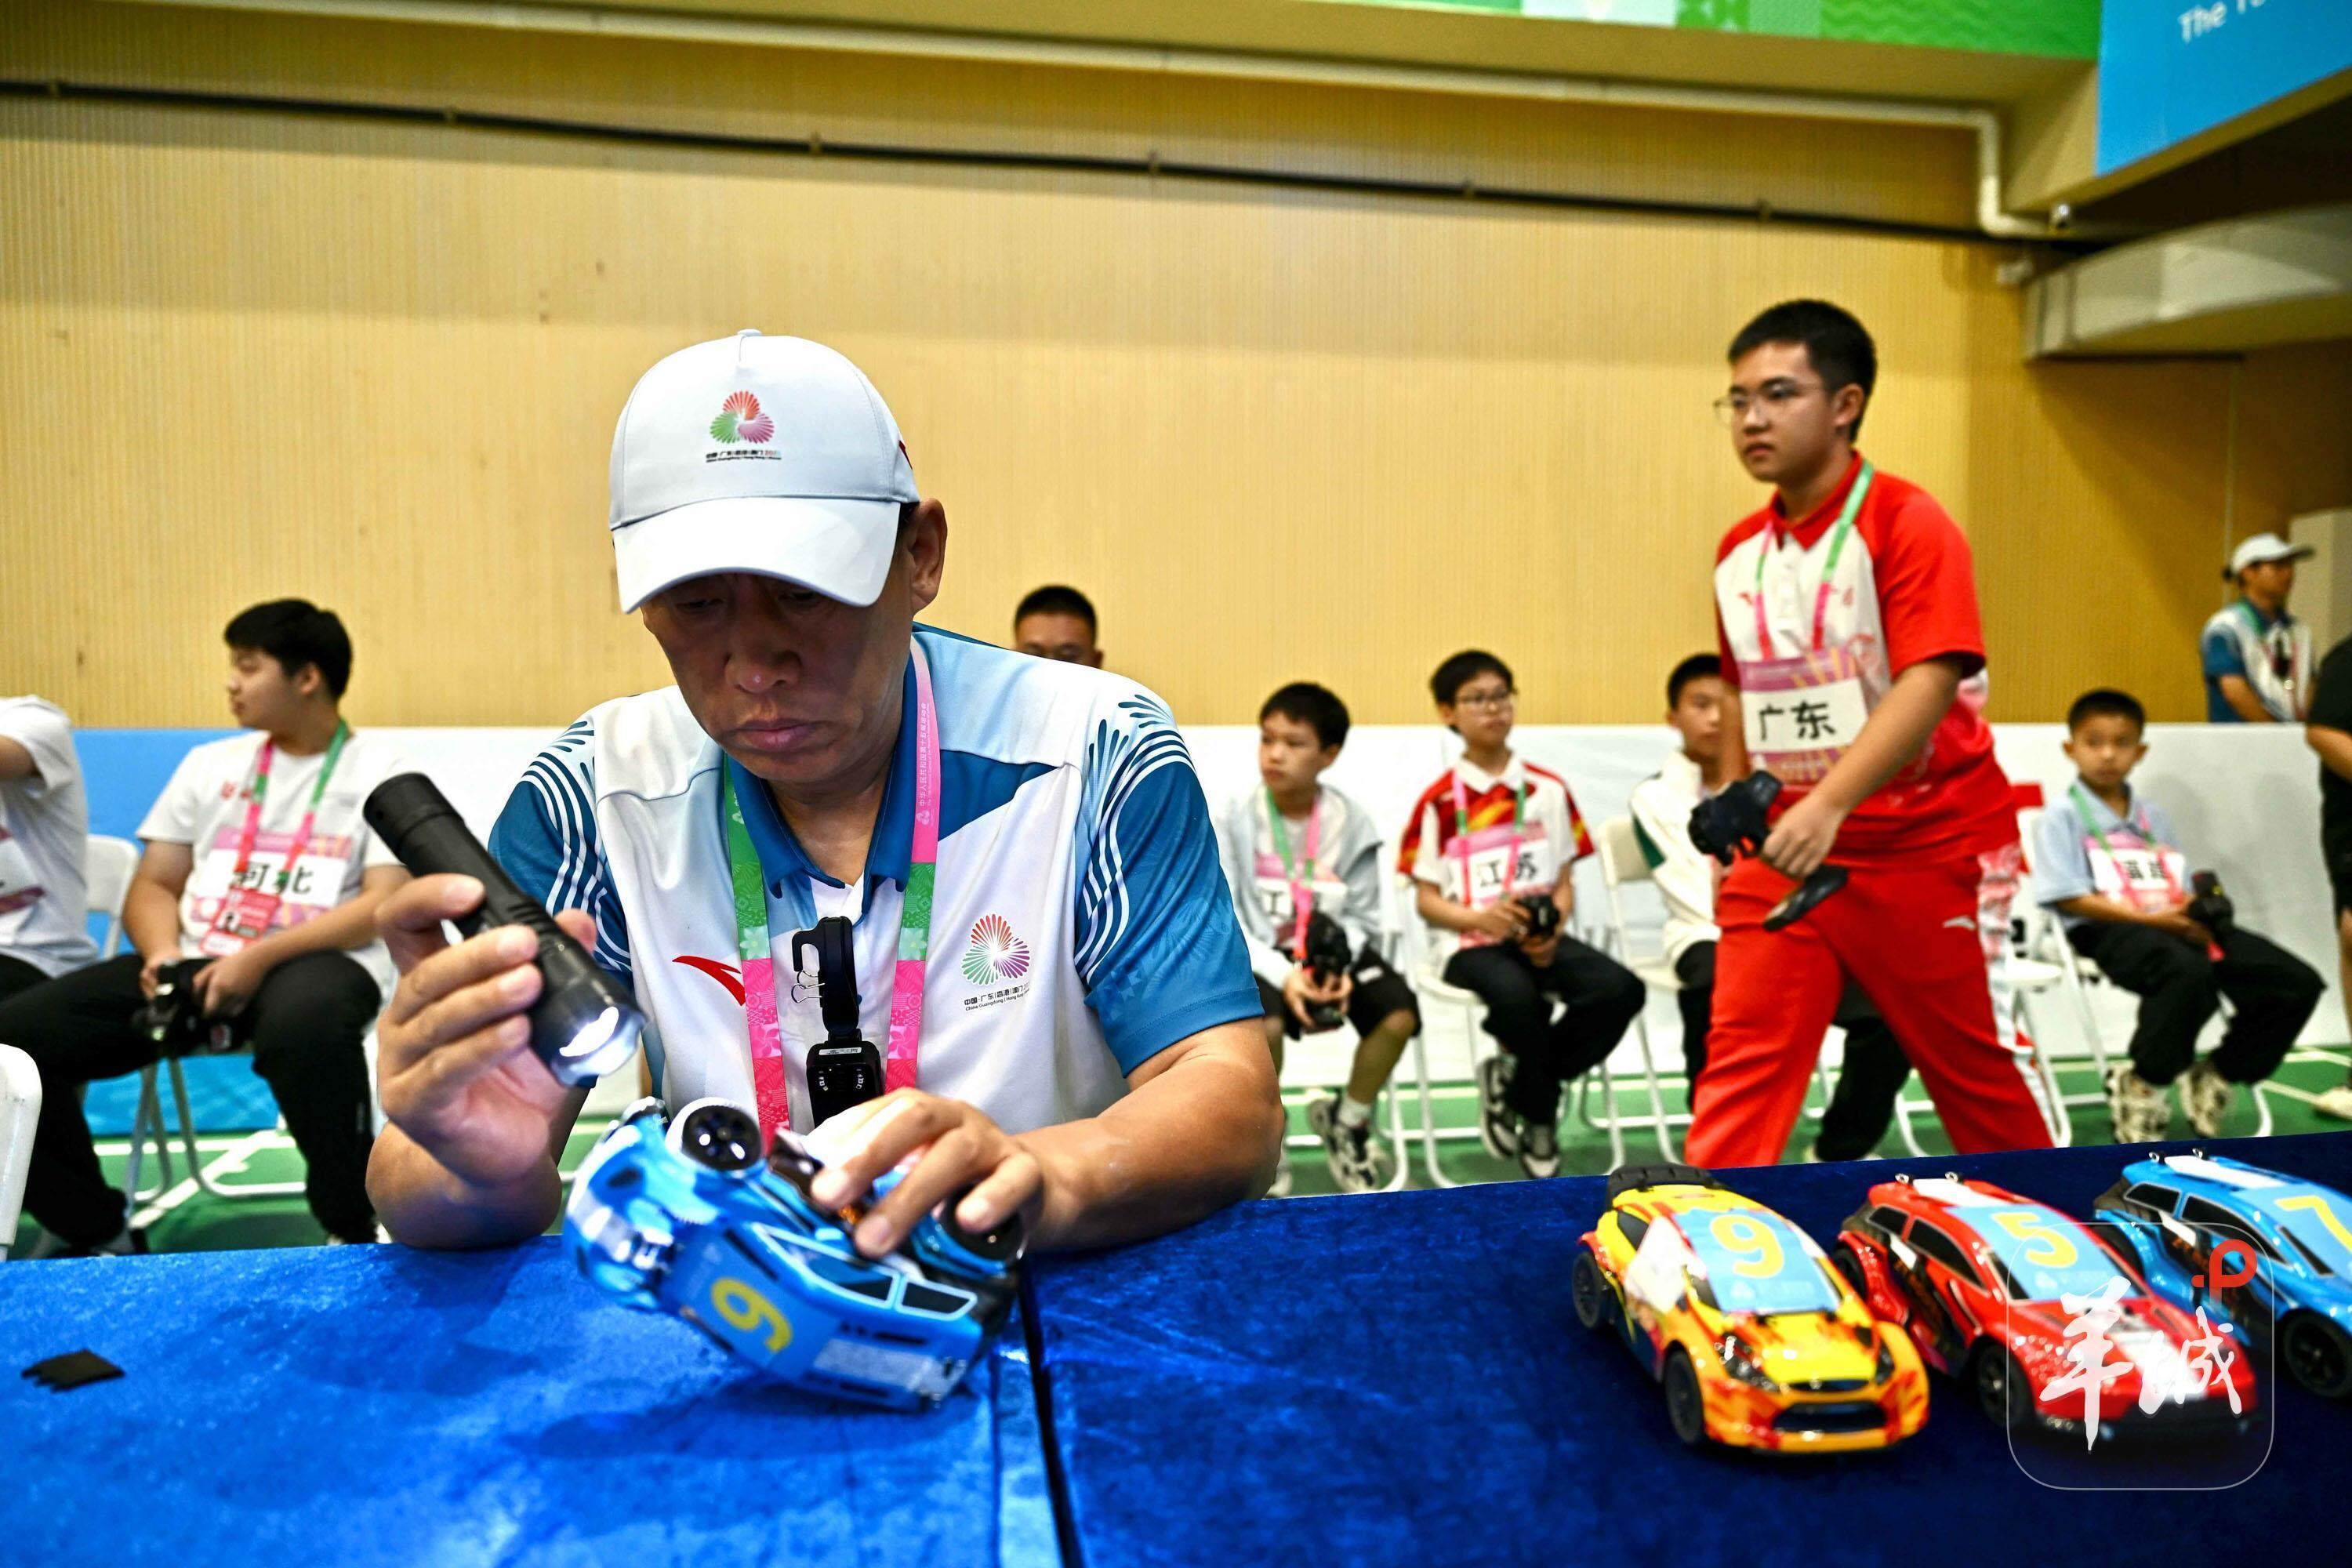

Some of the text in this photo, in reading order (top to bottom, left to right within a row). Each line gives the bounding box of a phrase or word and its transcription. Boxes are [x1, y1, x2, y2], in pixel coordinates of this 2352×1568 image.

[2177, 1, 2227, 44] The
[1759, 700, 1836, 741] 广东
[978, 998, 1004, 1008] Guangdong
[1710, 1214, 1784, 1278] 9
[1991, 1211, 2078, 1268] 5
[2275, 1195, 2352, 1254] 7
